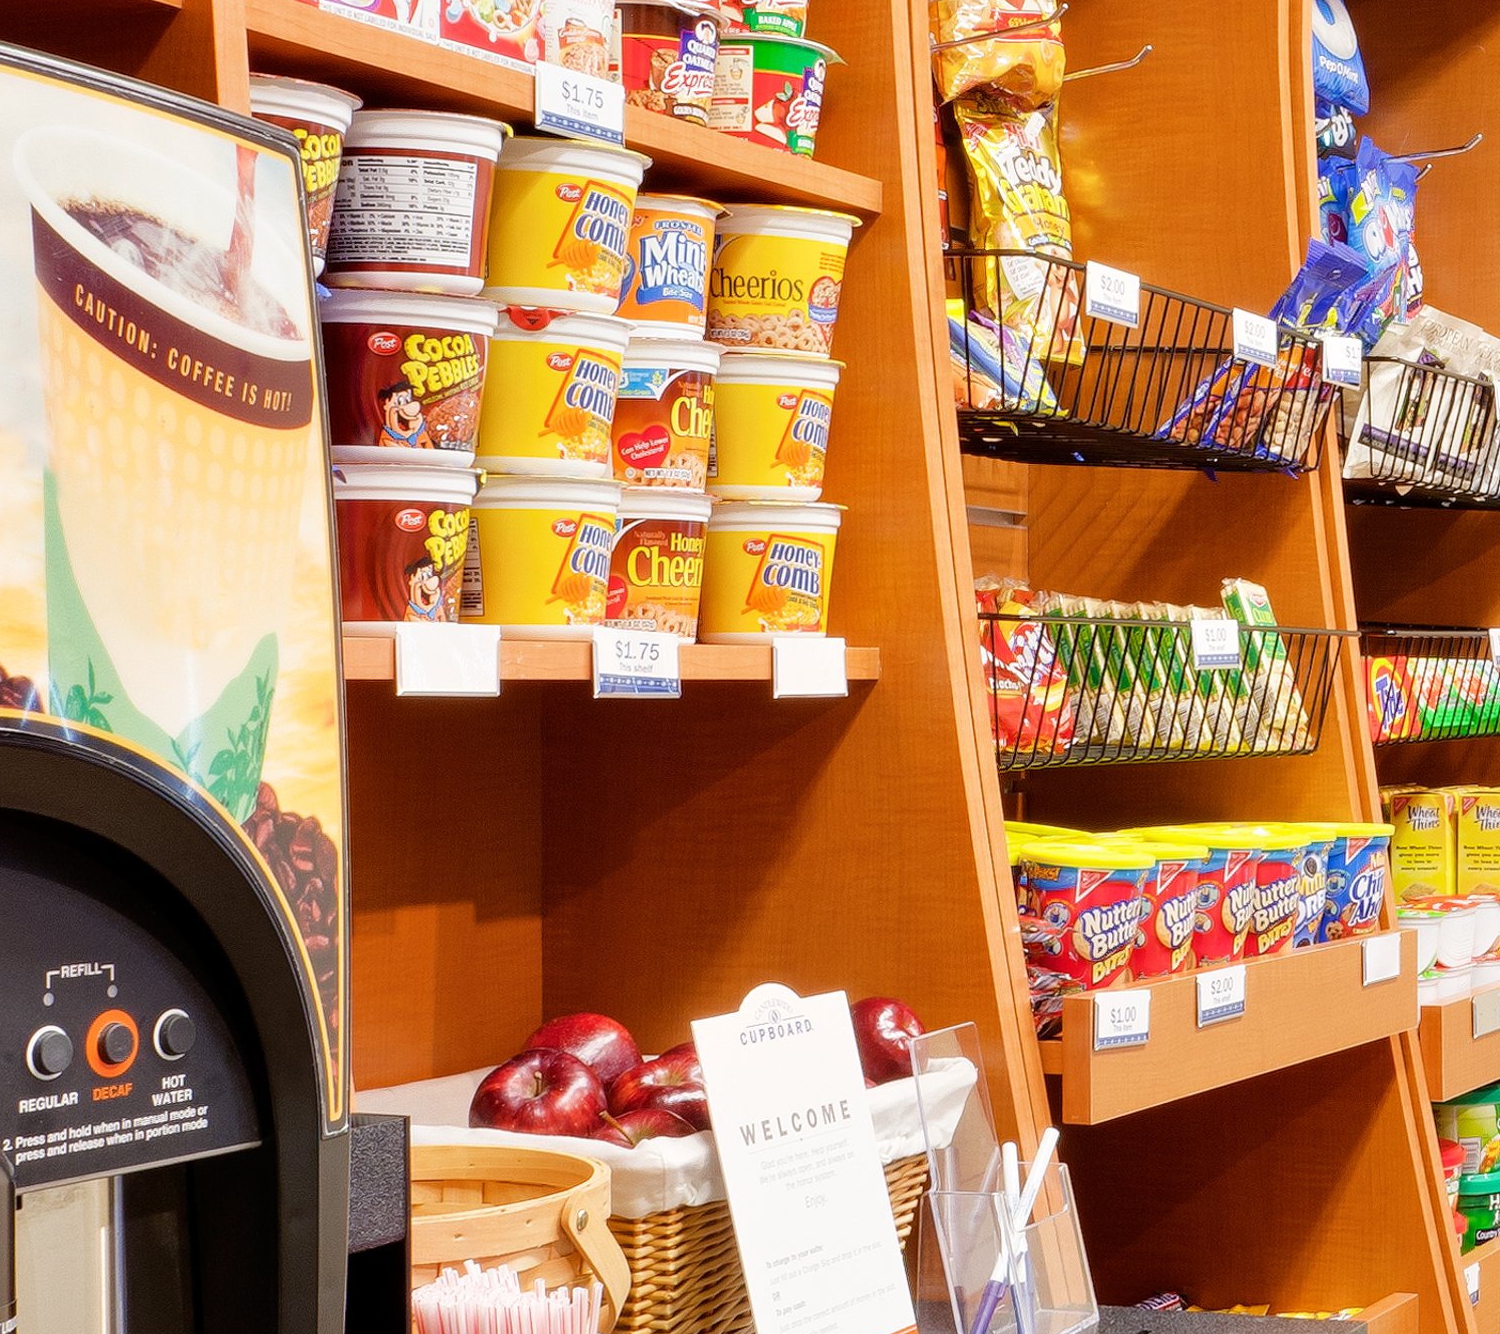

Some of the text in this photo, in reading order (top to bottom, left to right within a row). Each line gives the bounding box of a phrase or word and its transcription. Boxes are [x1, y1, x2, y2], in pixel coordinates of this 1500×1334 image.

[562, 80, 604, 110] $1.75
[1003, 152, 1062, 196] Teddy
[575, 213, 626, 257] COMB
[643, 231, 706, 271] Mini
[710, 269, 803, 303] Cheerios
[1100, 274, 1125, 297] $2.00
[75, 283, 293, 412] CAUTION: COFFEE IS HOT!
[373, 336, 397, 349] Post
[404, 334, 474, 363] COCOA
[401, 354, 481, 397] PEBBLES
[549, 355, 572, 367] Post
[763, 563, 820, 595] COMB
[615, 640, 660, 661] $1.75
[1407, 805, 1440, 822] Wheat
[1407, 818, 1440, 831] Thins
[1081, 899, 1142, 941] Nutter
[61, 962, 103, 978] REFILL
[1210, 976, 1234, 995] $2.00
[1110, 1006, 1136, 1024] $1.00
[739, 1019, 812, 1046] CUPBOARD
[162, 1074, 186, 1090] HOT
[19, 1083, 133, 1114] REGULAR DECAF
[152, 1088, 193, 1106] WATER
[15, 1133, 45, 1150] Press
[47, 1128, 67, 1142] and
[69, 1123, 92, 1139] hold
[93, 1120, 120, 1135] when
[122, 1117, 132, 1129] in
[133, 1111, 168, 1128] manual
[170, 1107, 196, 1121] mode
[197, 1105, 208, 1116] or
[740, 1099, 850, 1146] WELCOME
[15, 1118, 208, 1166] press and release when in portion mode
